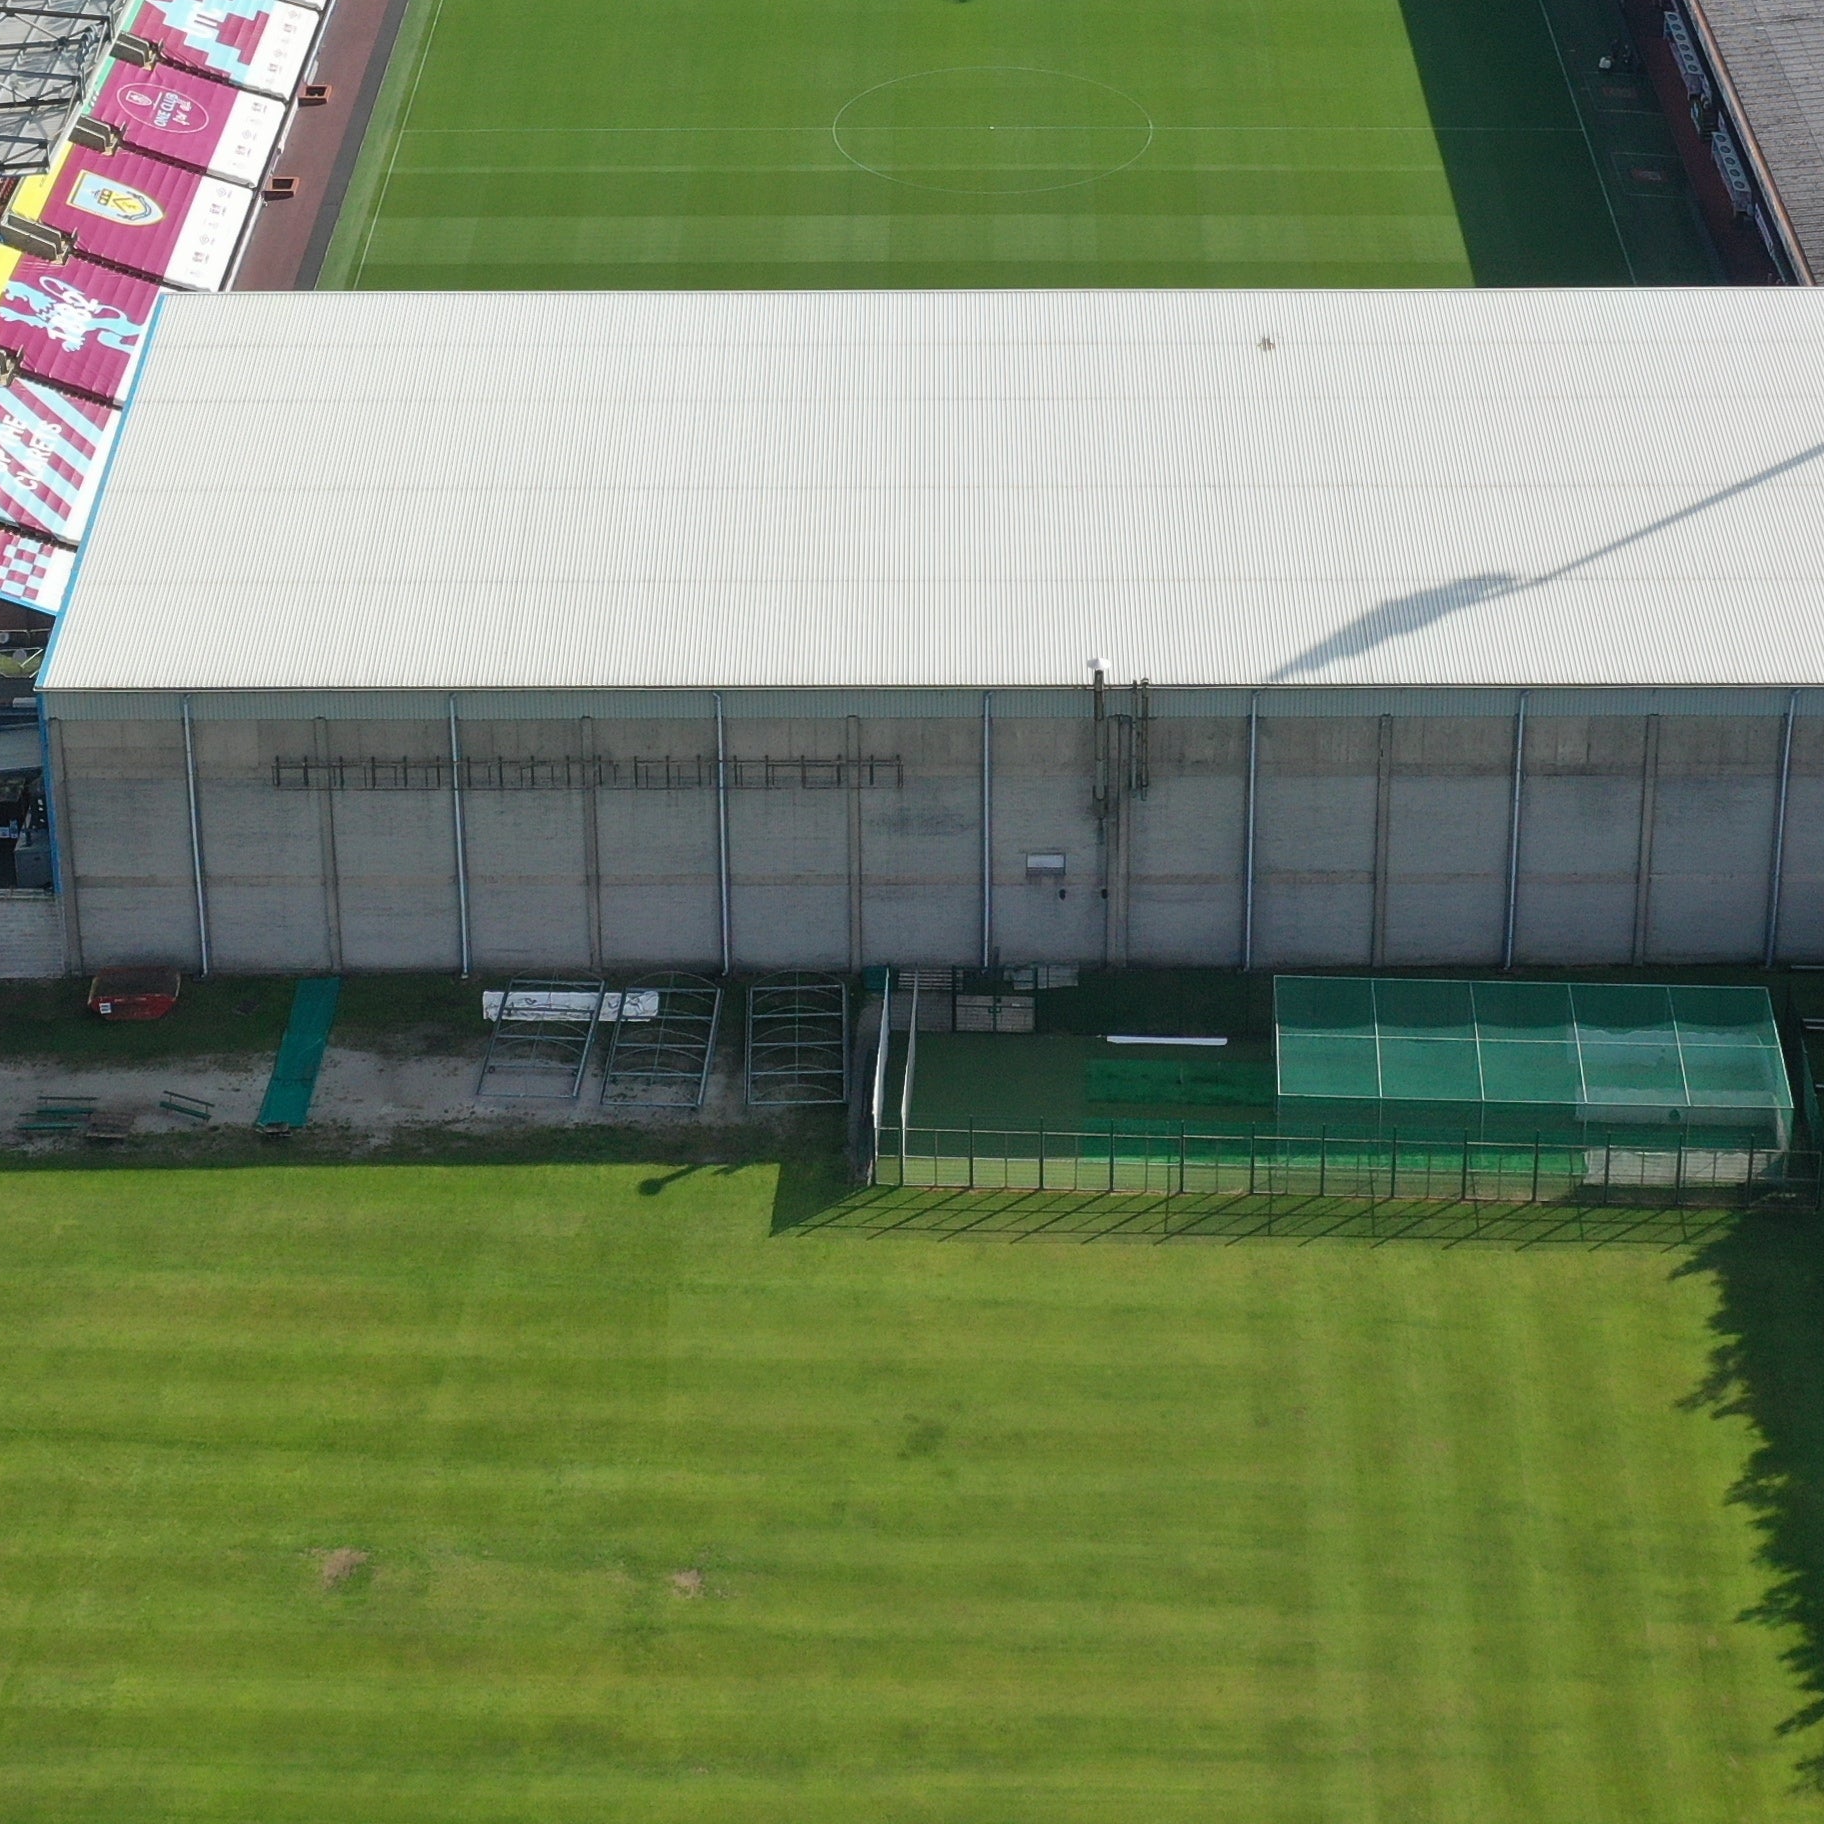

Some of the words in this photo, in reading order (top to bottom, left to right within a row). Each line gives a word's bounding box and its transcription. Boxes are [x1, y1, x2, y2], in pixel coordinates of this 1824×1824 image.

[153, 109, 171, 128] ONE
[162, 91, 180, 113] CLUB
[14, 419, 63, 491] CLARETS
